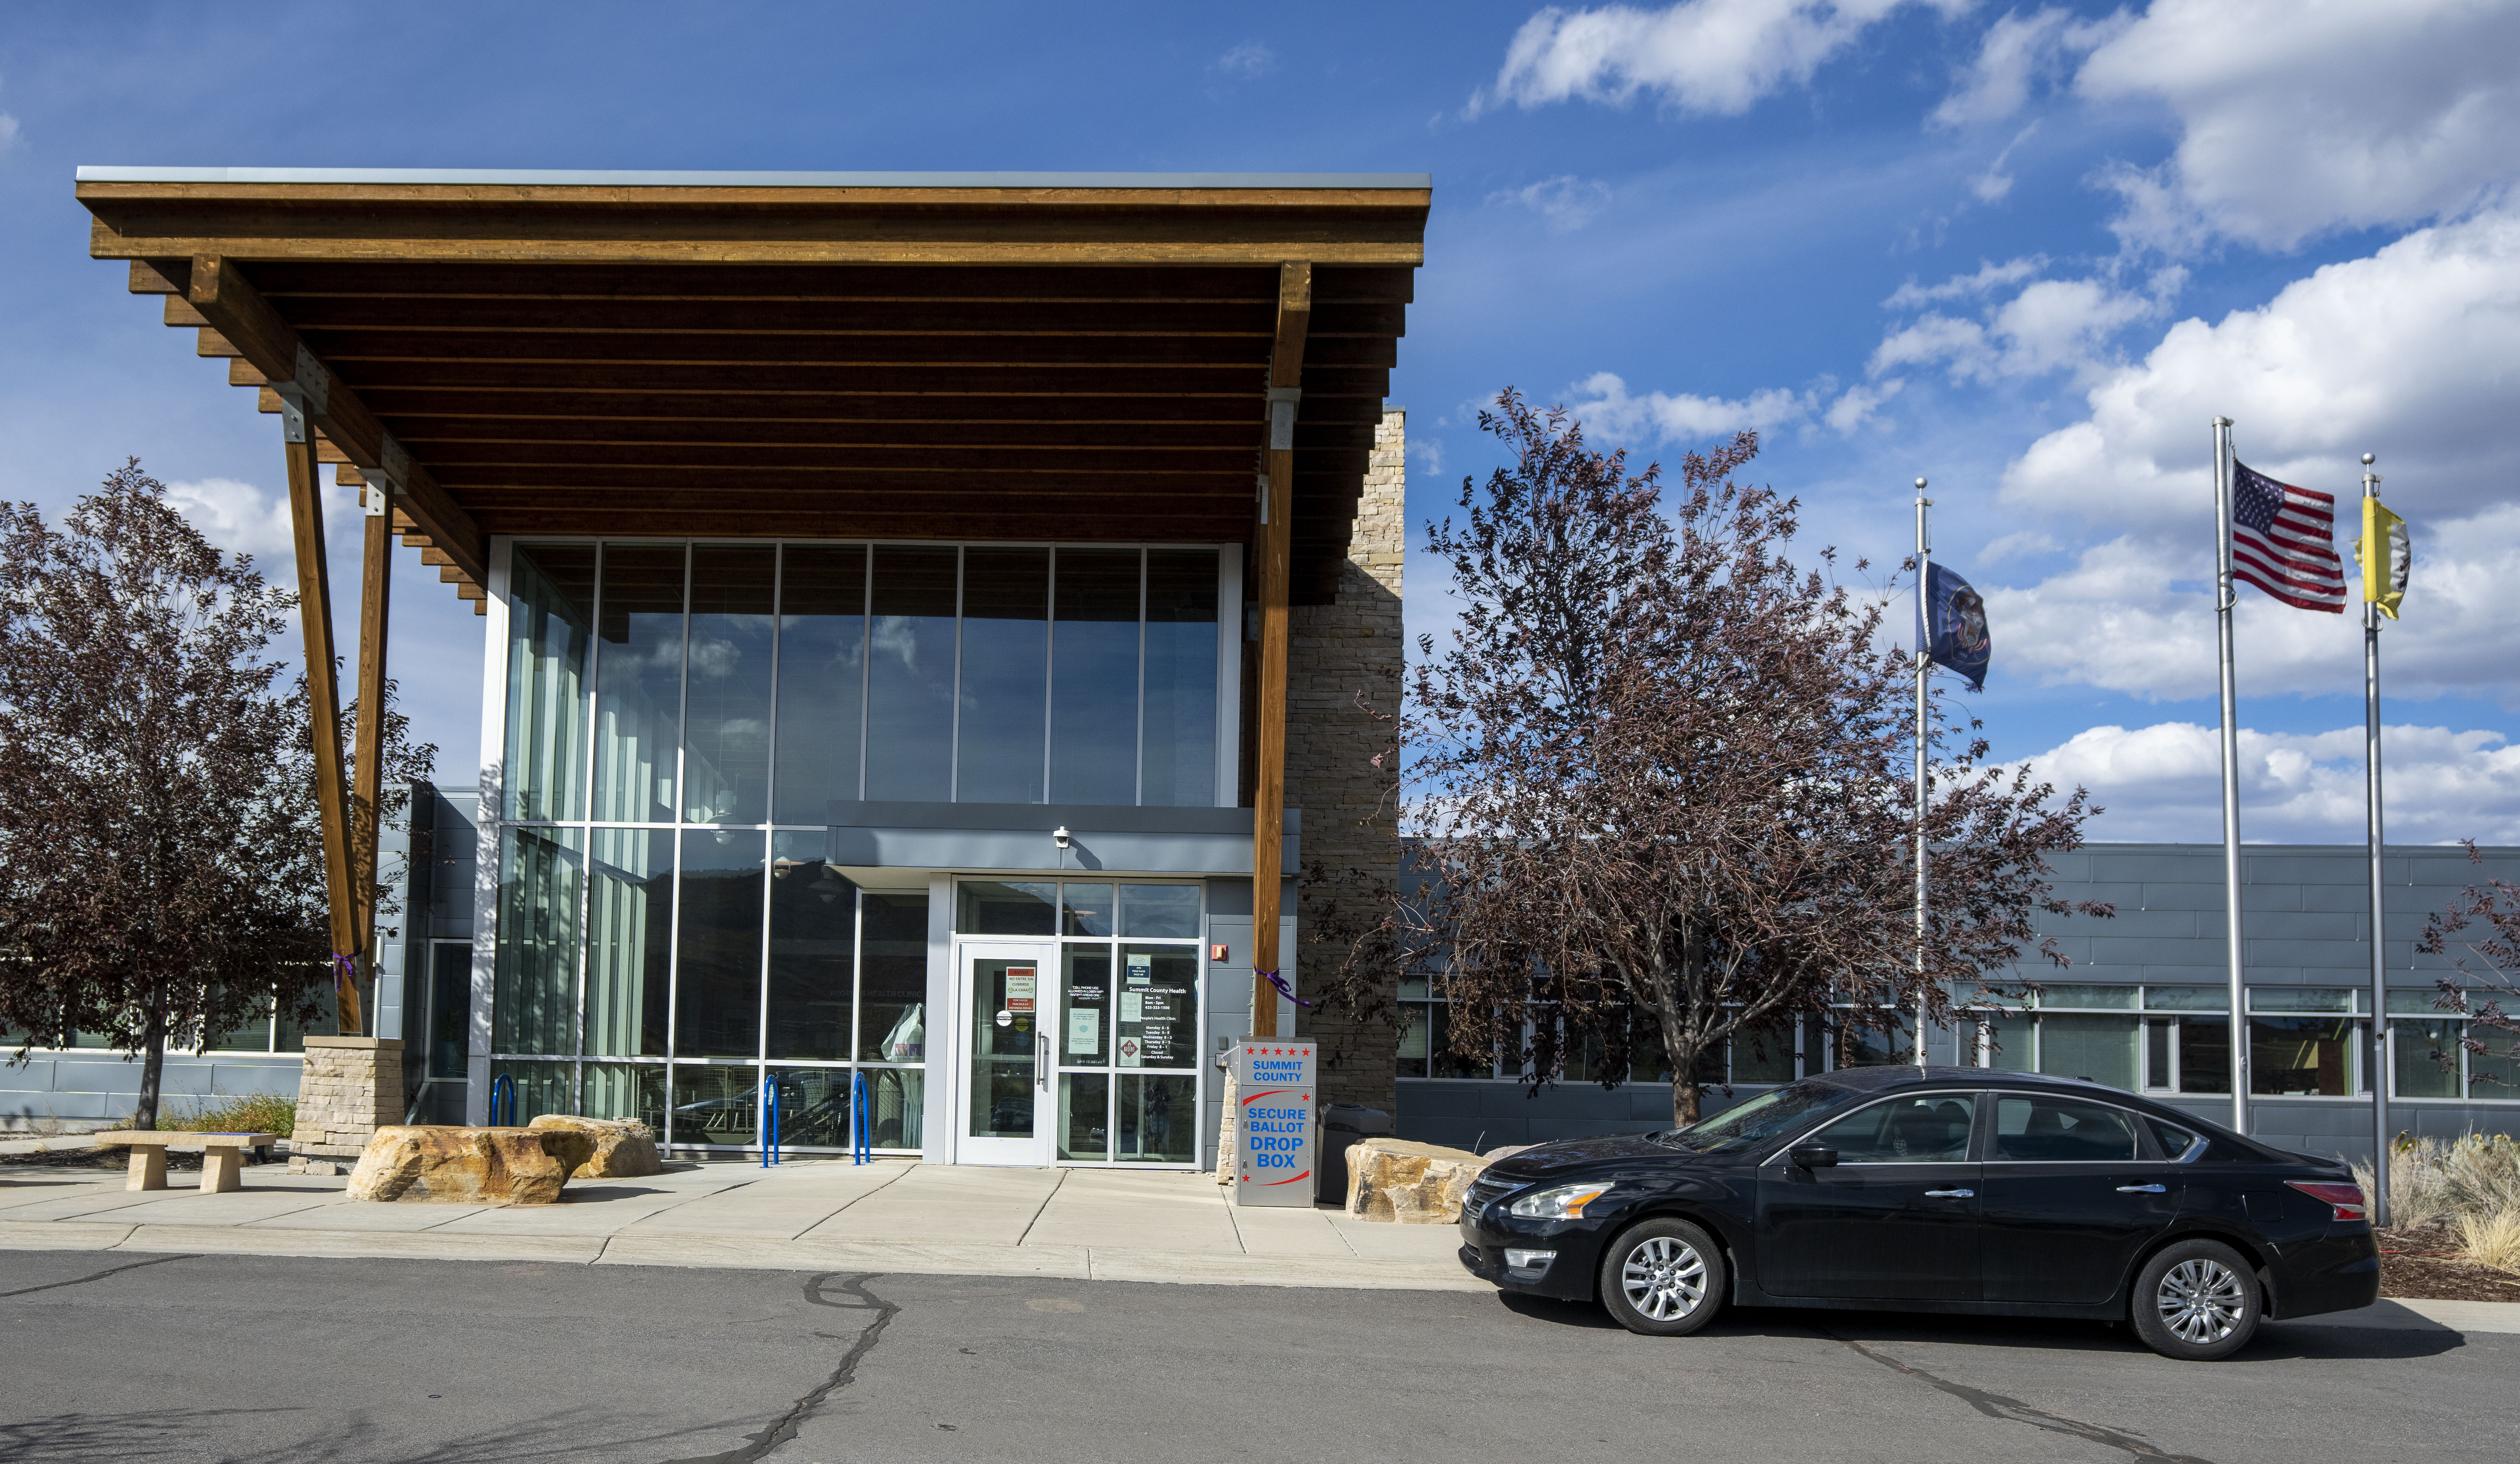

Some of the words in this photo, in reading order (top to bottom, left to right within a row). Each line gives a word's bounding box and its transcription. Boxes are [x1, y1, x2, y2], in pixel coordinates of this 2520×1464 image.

[1253, 1060, 1303, 1070] SUMMIT
[1254, 1072, 1302, 1082] COUNTY
[1248, 1108, 1306, 1120] SECURE
[1251, 1121, 1304, 1133] BALLOT
[1251, 1137, 1303, 1151] DROP
[1257, 1153, 1296, 1168] BOX
